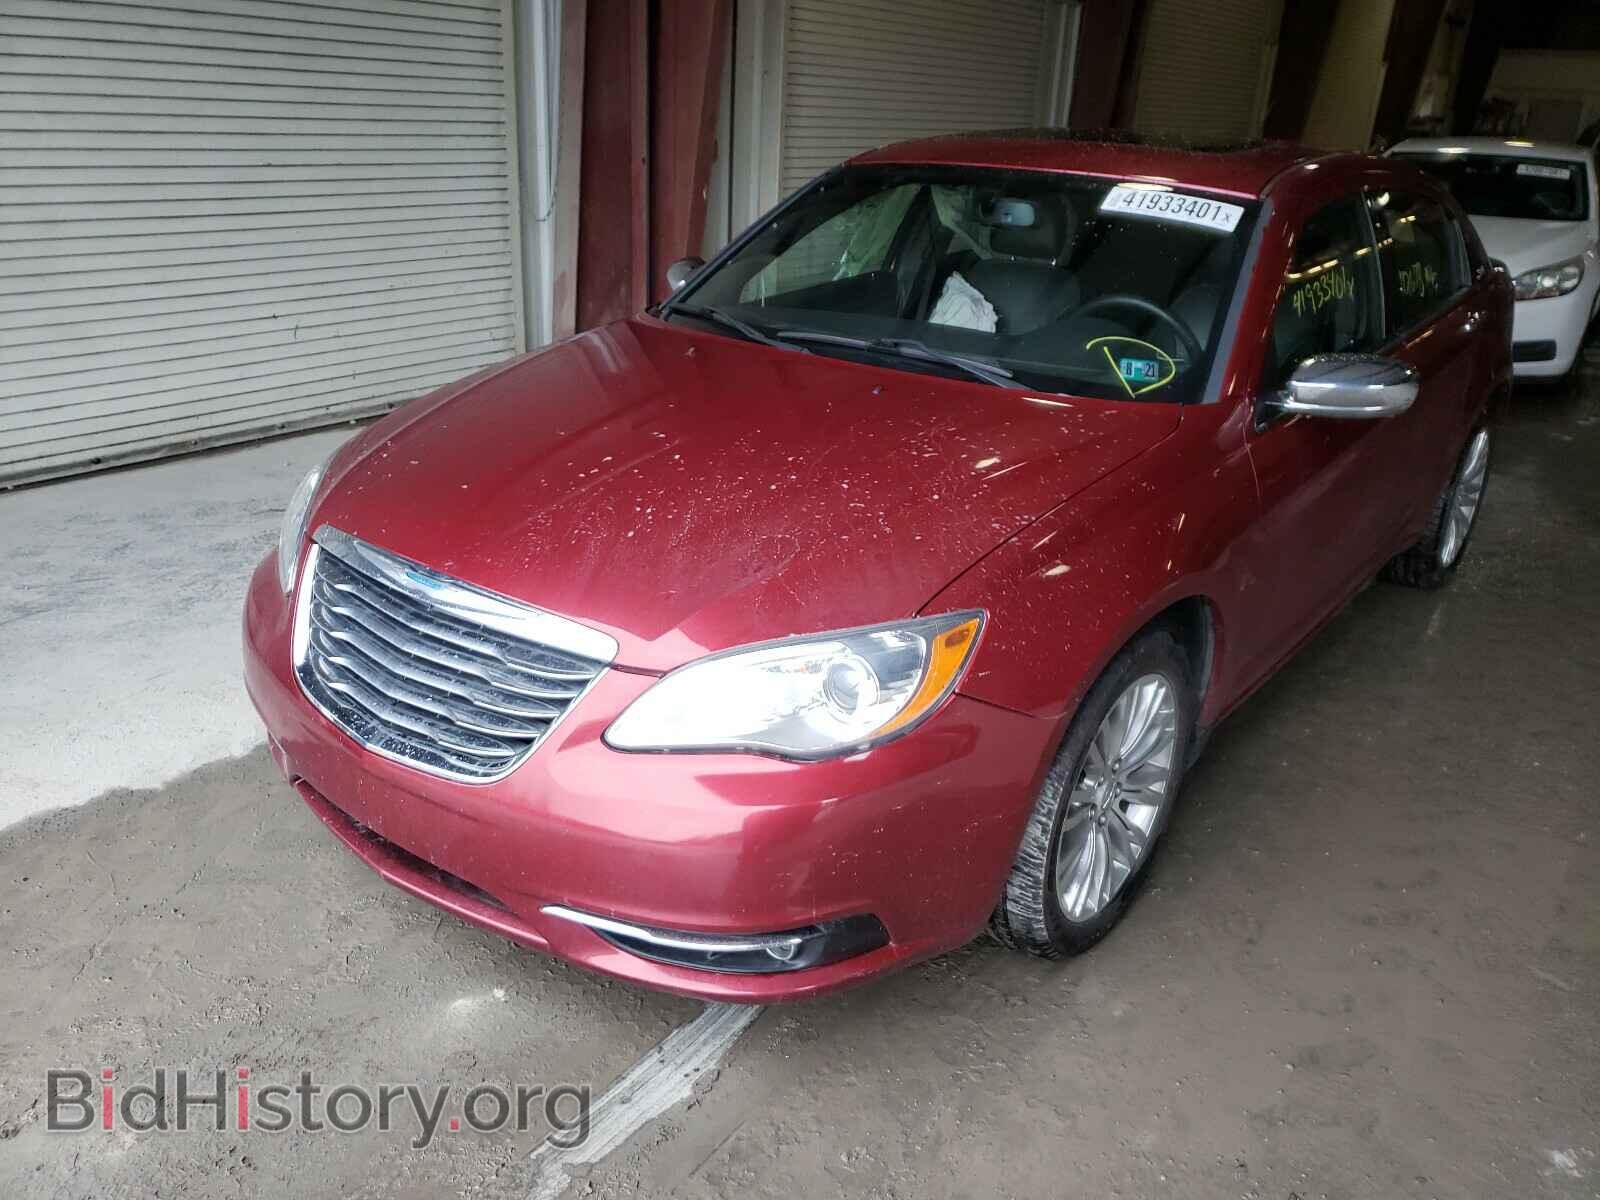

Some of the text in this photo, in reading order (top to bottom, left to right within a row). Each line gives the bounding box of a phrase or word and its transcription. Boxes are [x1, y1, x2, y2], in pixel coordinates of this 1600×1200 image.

[1122, 191, 1222, 222] 41933401
[1126, 361, 1155, 378] 8 21
